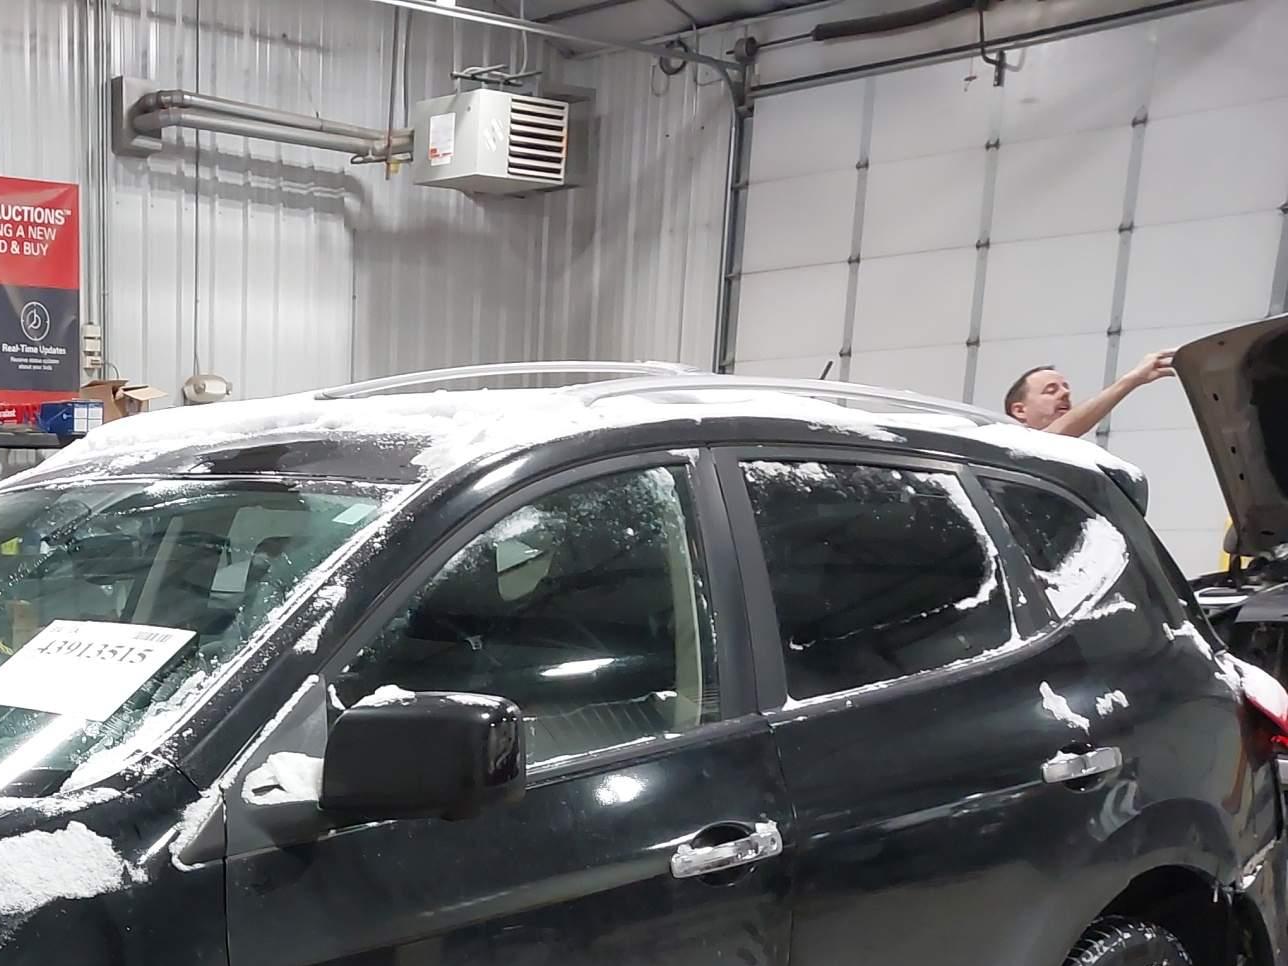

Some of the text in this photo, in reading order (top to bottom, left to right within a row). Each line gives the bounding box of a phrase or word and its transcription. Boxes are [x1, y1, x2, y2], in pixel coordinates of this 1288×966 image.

[15, 225, 25, 237] A
[27, 226, 56, 240] NEW
[10, 240, 20, 254] &
[23, 242, 49, 256] BUY
[1, 343, 67, 356] Real-Time Updates
[37, 639, 155, 664] 43913515
